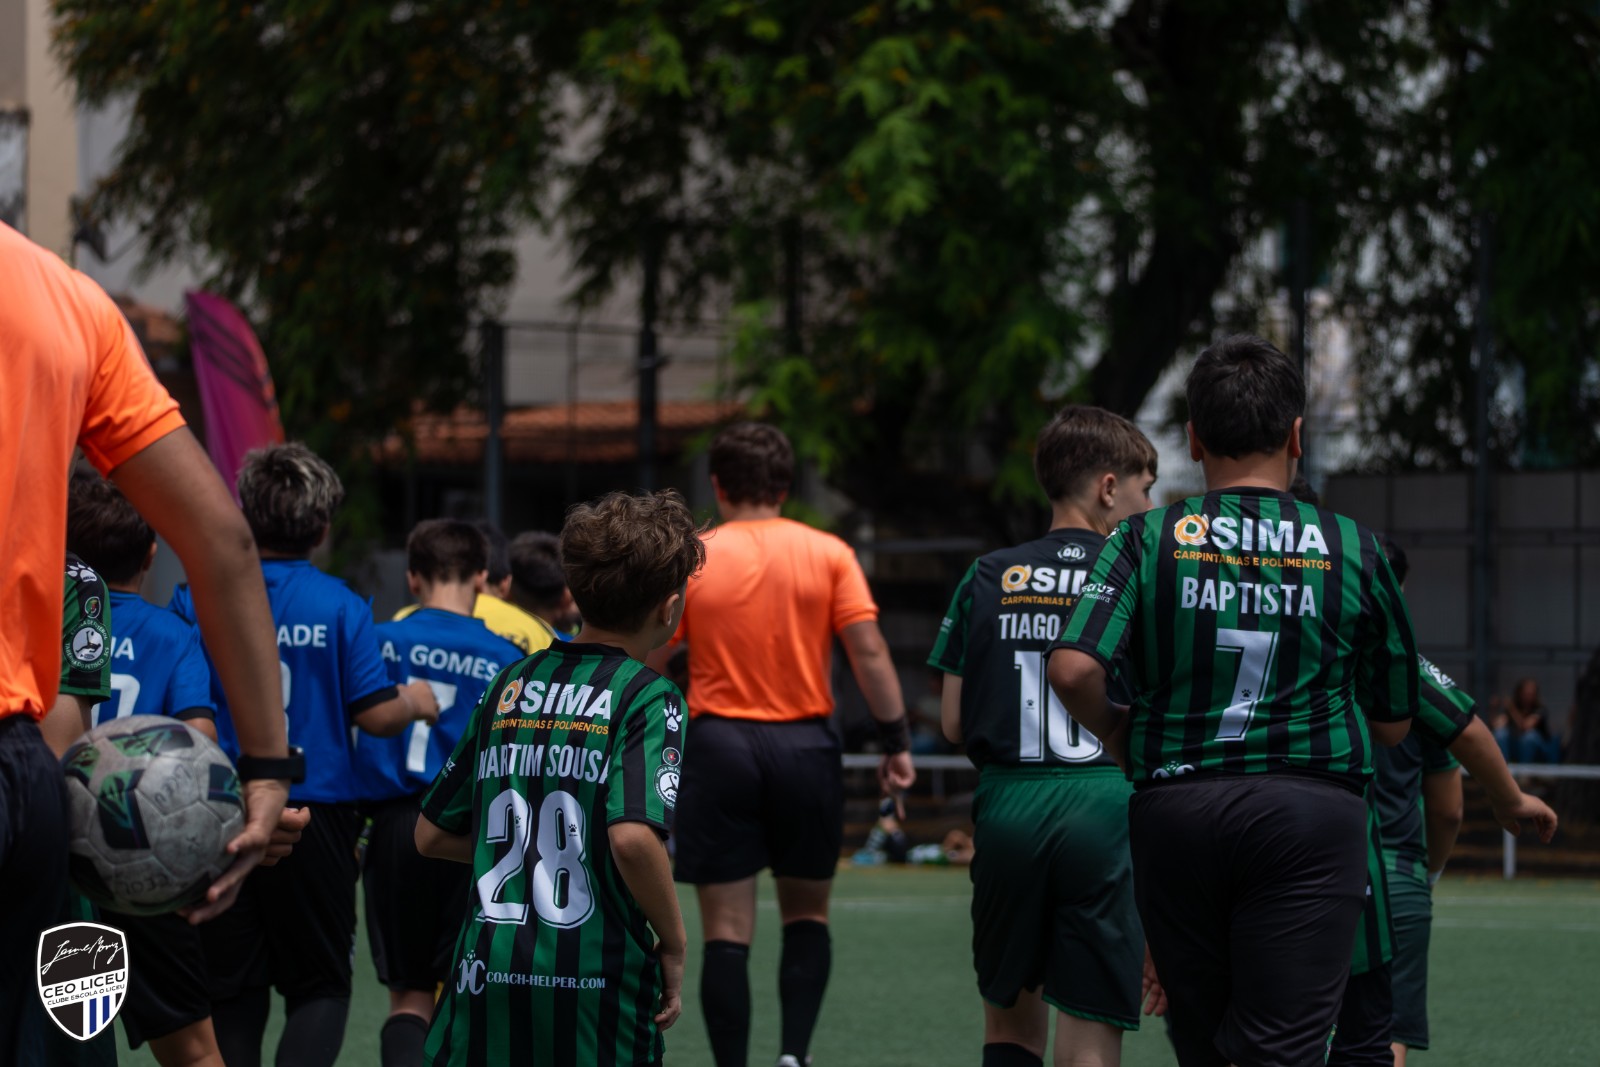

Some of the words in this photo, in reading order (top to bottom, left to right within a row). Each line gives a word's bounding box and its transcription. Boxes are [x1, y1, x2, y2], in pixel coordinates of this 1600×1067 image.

[1173, 550, 1250, 567] CARPINTARIAS
[1252, 556, 1260, 567] E
[1261, 557, 1332, 571] POLIMENTOS
[1031, 567, 1088, 595] SI
[1001, 595, 1064, 606] CARPINTARIAS
[1065, 597, 1072, 607] E
[1181, 576, 1317, 618] BAPTISTA
[998, 613, 1062, 641] TIAGO
[409, 644, 499, 682] GOMES
[1214, 629, 1280, 742] 7
[406, 675, 458, 773] 7
[491, 718, 546, 731] CARPINTARIAS
[546, 719, 552, 729] E
[553, 719, 609, 735] POLIMENTOS
[475, 788, 596, 929] 28
[486, 971, 606, 989] COACH-HELPER.COM
